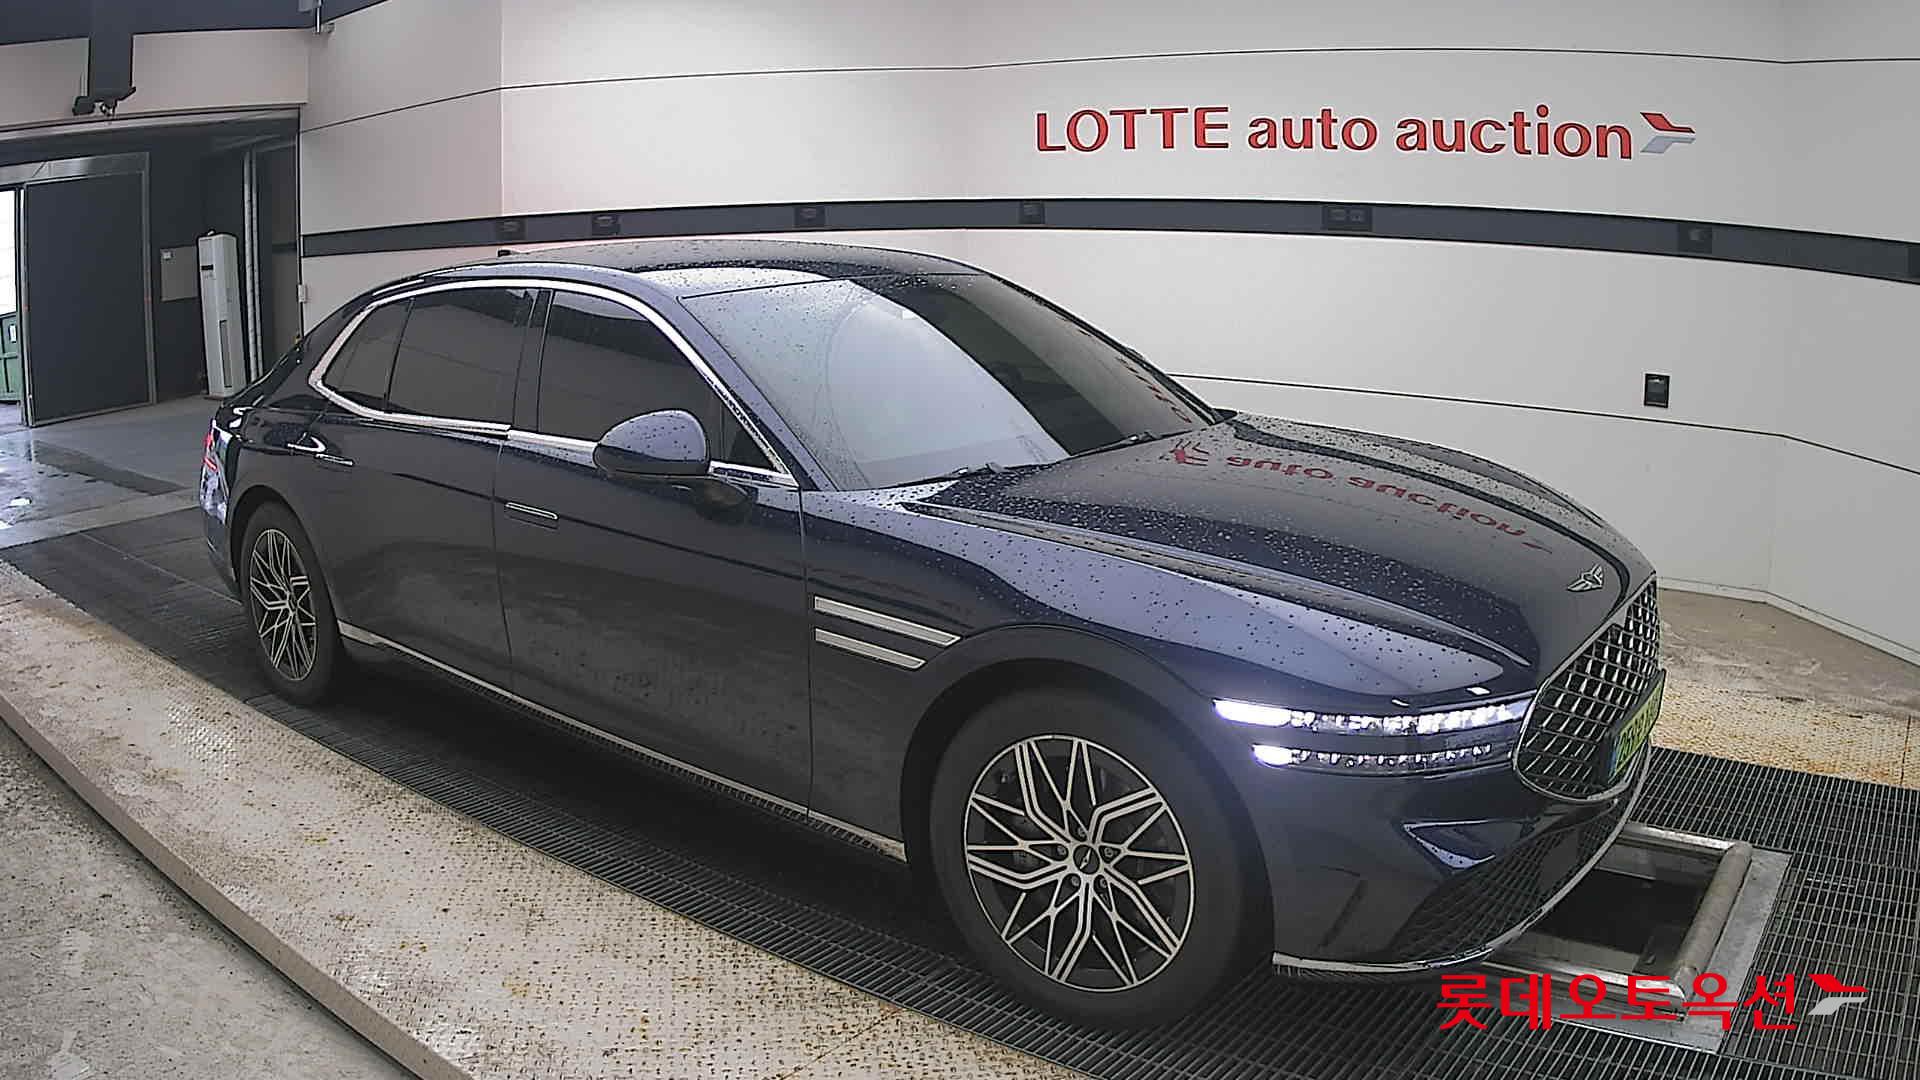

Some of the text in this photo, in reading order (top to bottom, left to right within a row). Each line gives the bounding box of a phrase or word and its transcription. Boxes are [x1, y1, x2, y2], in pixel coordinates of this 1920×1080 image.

[1036, 104, 1632, 159] LOTTE auto auction
